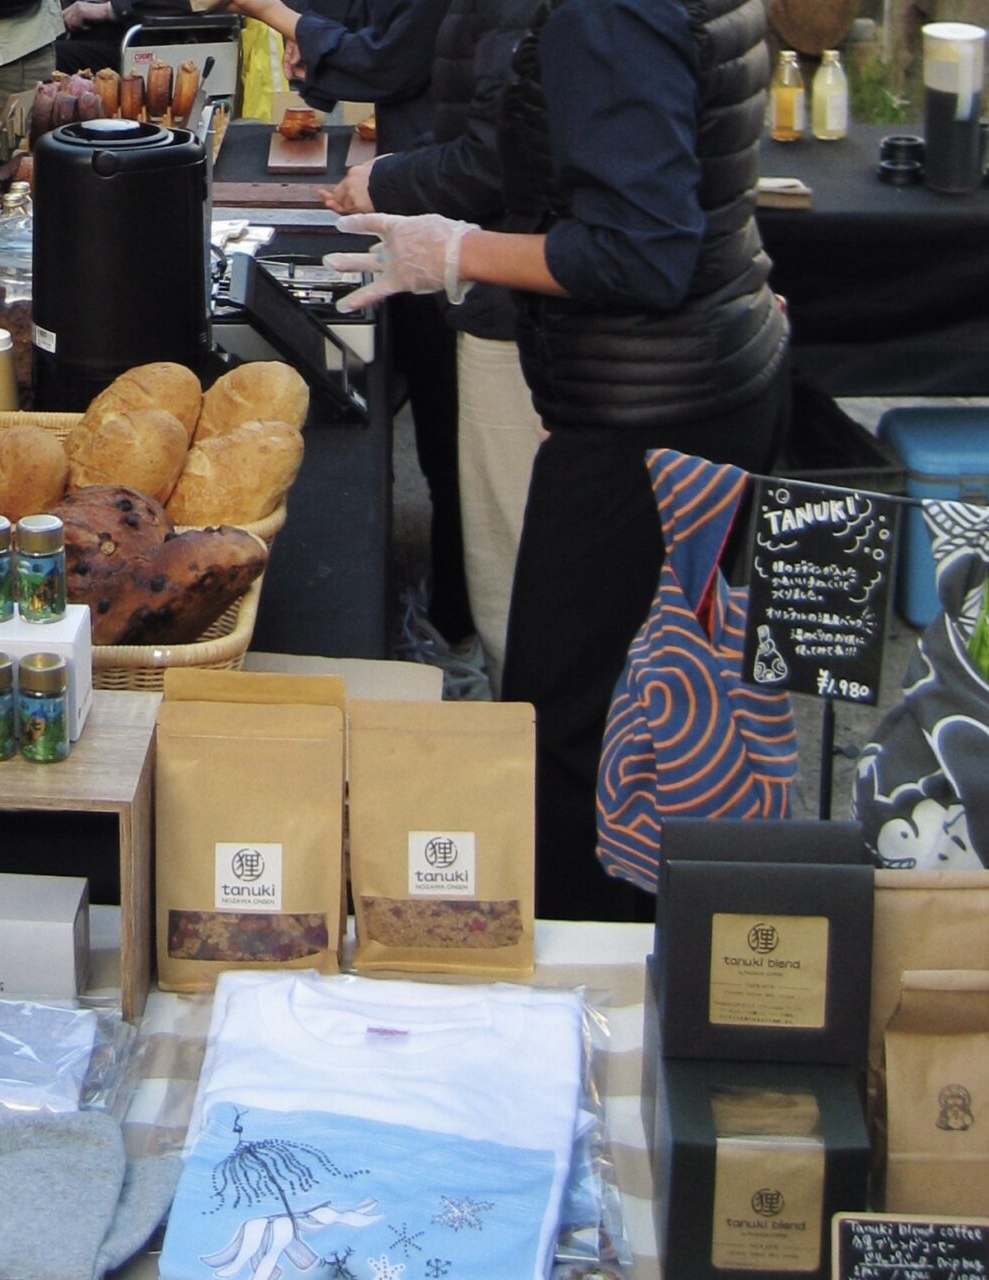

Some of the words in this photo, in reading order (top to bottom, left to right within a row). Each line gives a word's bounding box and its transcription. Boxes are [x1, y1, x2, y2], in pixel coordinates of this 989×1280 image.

[763, 495, 857, 535] TANUKI
[415, 870, 469, 882] tanuki
[221, 884, 275, 896] tanuki
[723, 956, 764, 967] tanuki
[767, 958, 801, 969] blend
[726, 1219, 768, 1229] tanuki
[772, 1220, 806, 1231] blend
